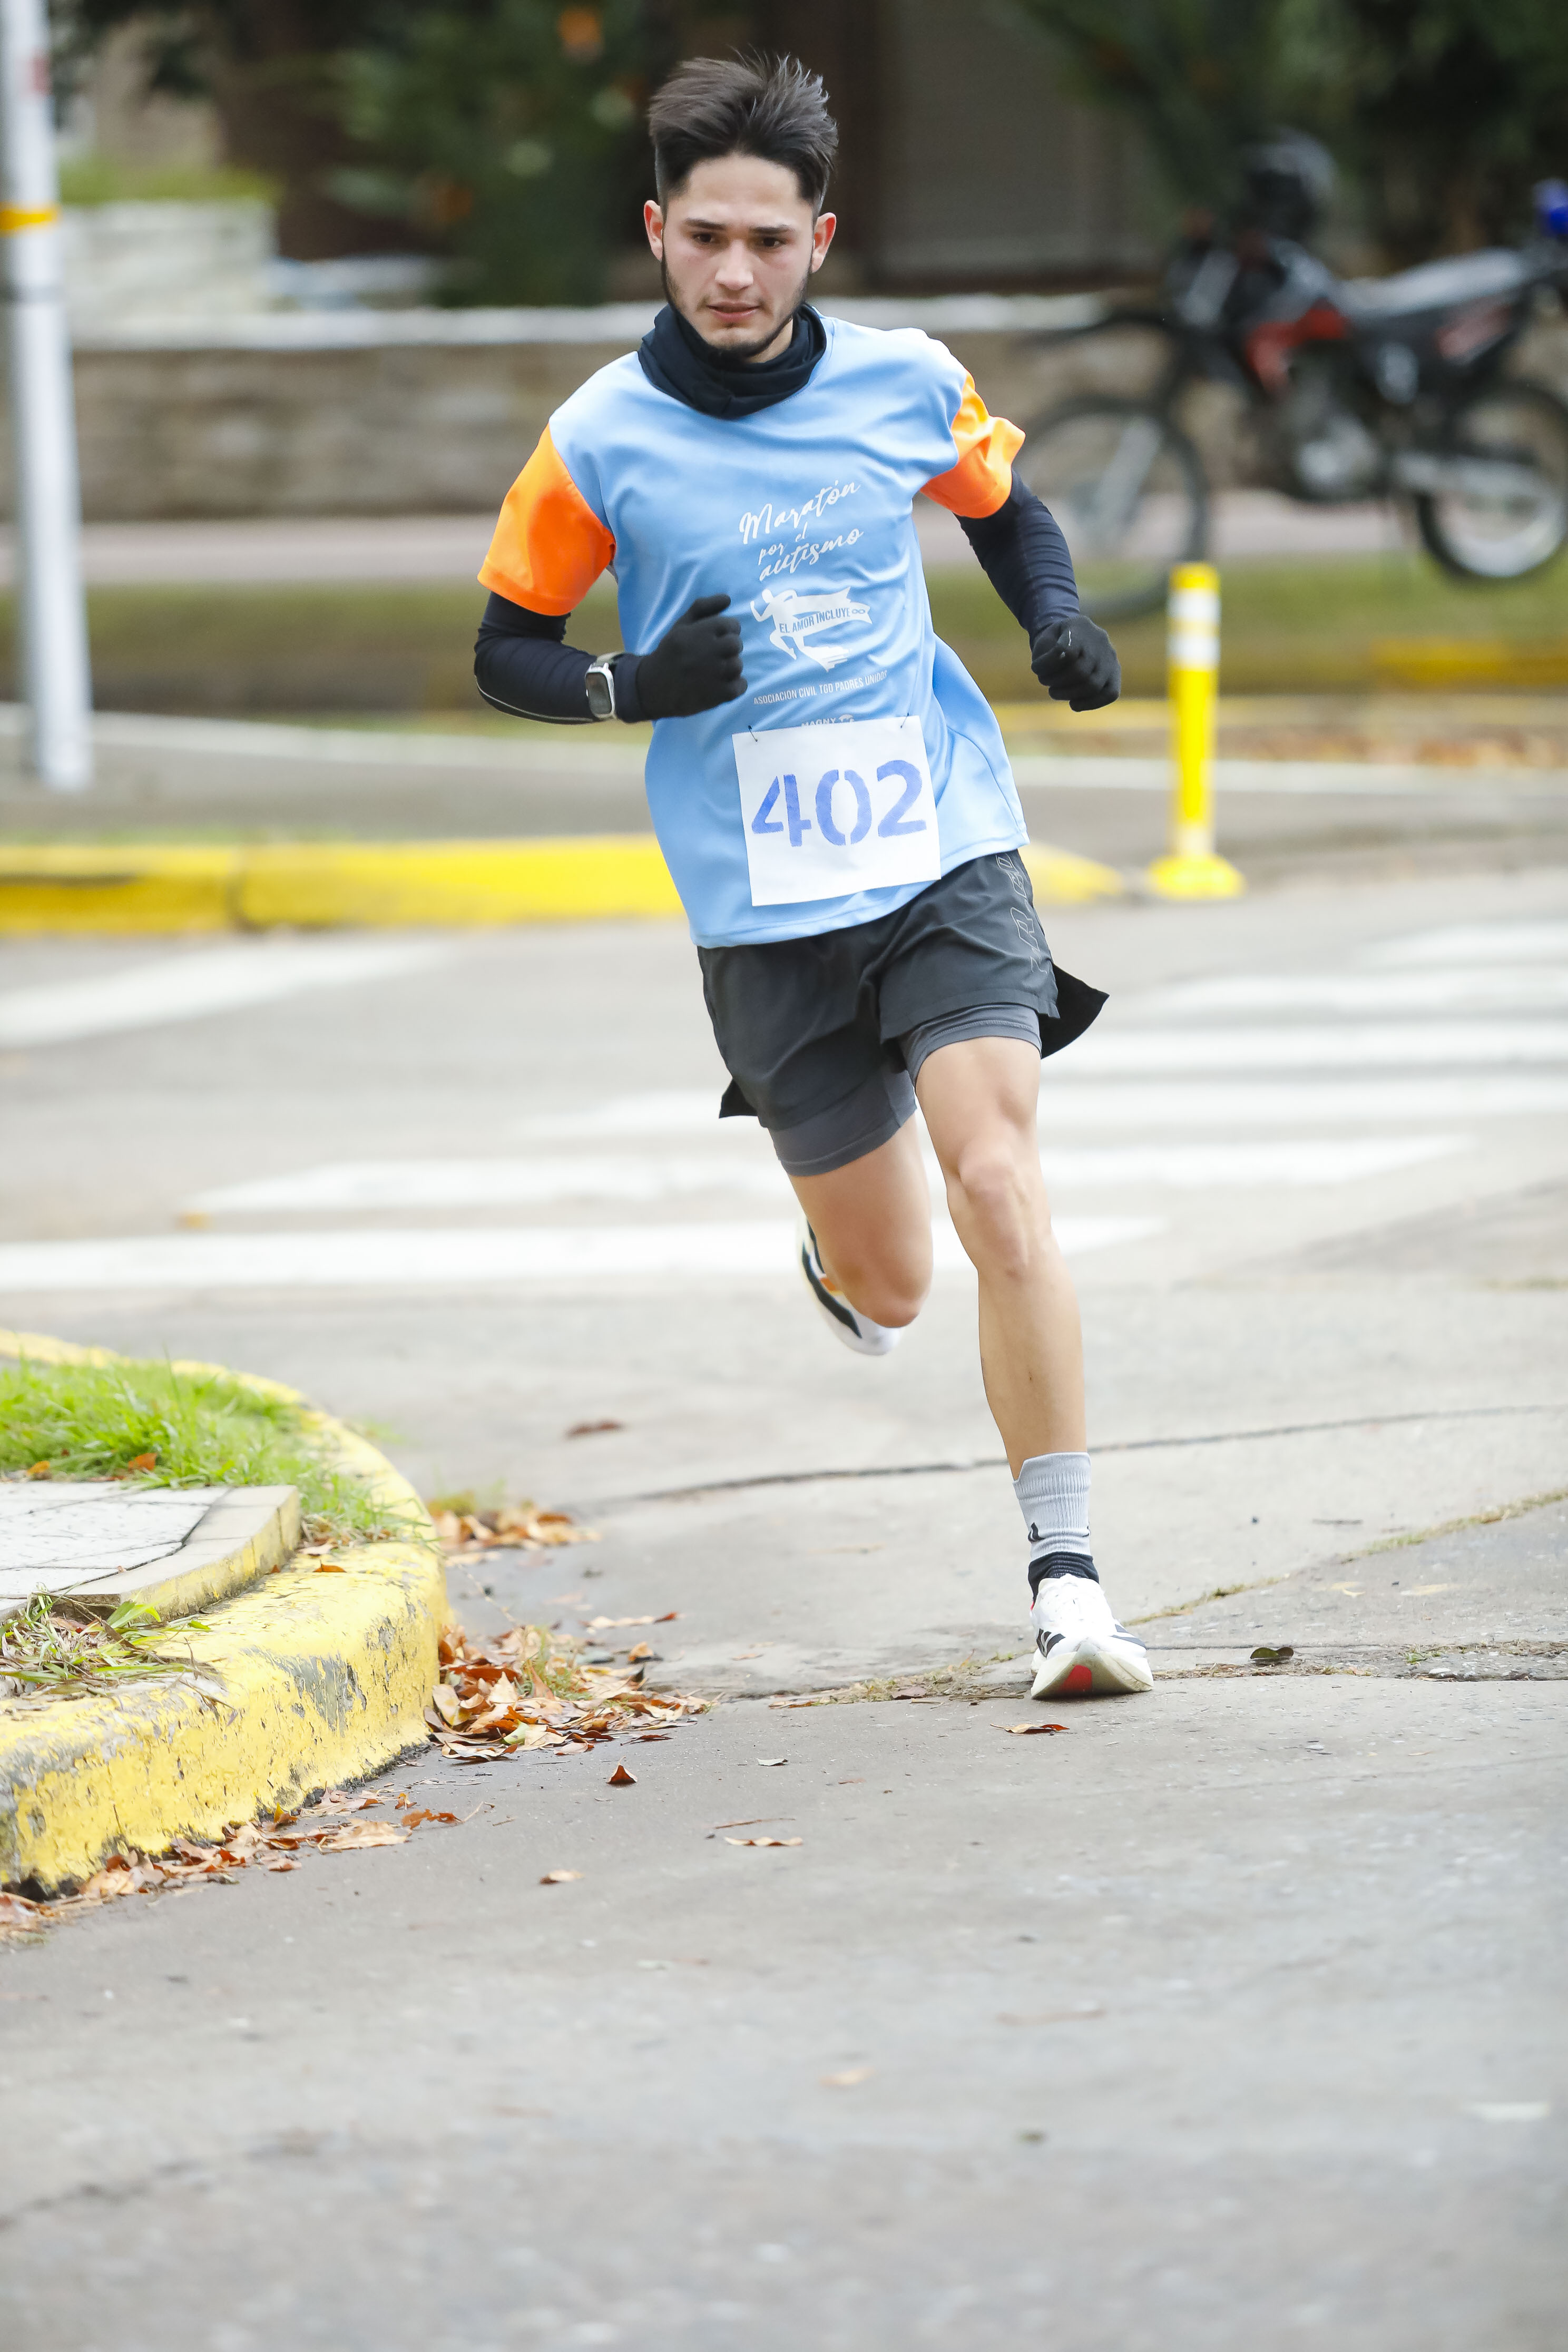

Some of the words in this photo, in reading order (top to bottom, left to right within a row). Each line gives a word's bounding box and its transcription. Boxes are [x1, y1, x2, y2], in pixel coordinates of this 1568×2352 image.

[739, 480, 861, 545] Maratón
[758, 543, 786, 566] por
[795, 521, 808, 543] el
[759, 528, 864, 582] autismo
[779, 623, 790, 633] EL
[792, 615, 815, 633] AMOR
[816, 607, 850, 624] INCLUYE
[798, 685, 818, 698] CIVIL
[835, 677, 864, 692] PADRES
[865, 669, 888, 685] UNIDOS
[751, 760, 927, 847] 402
